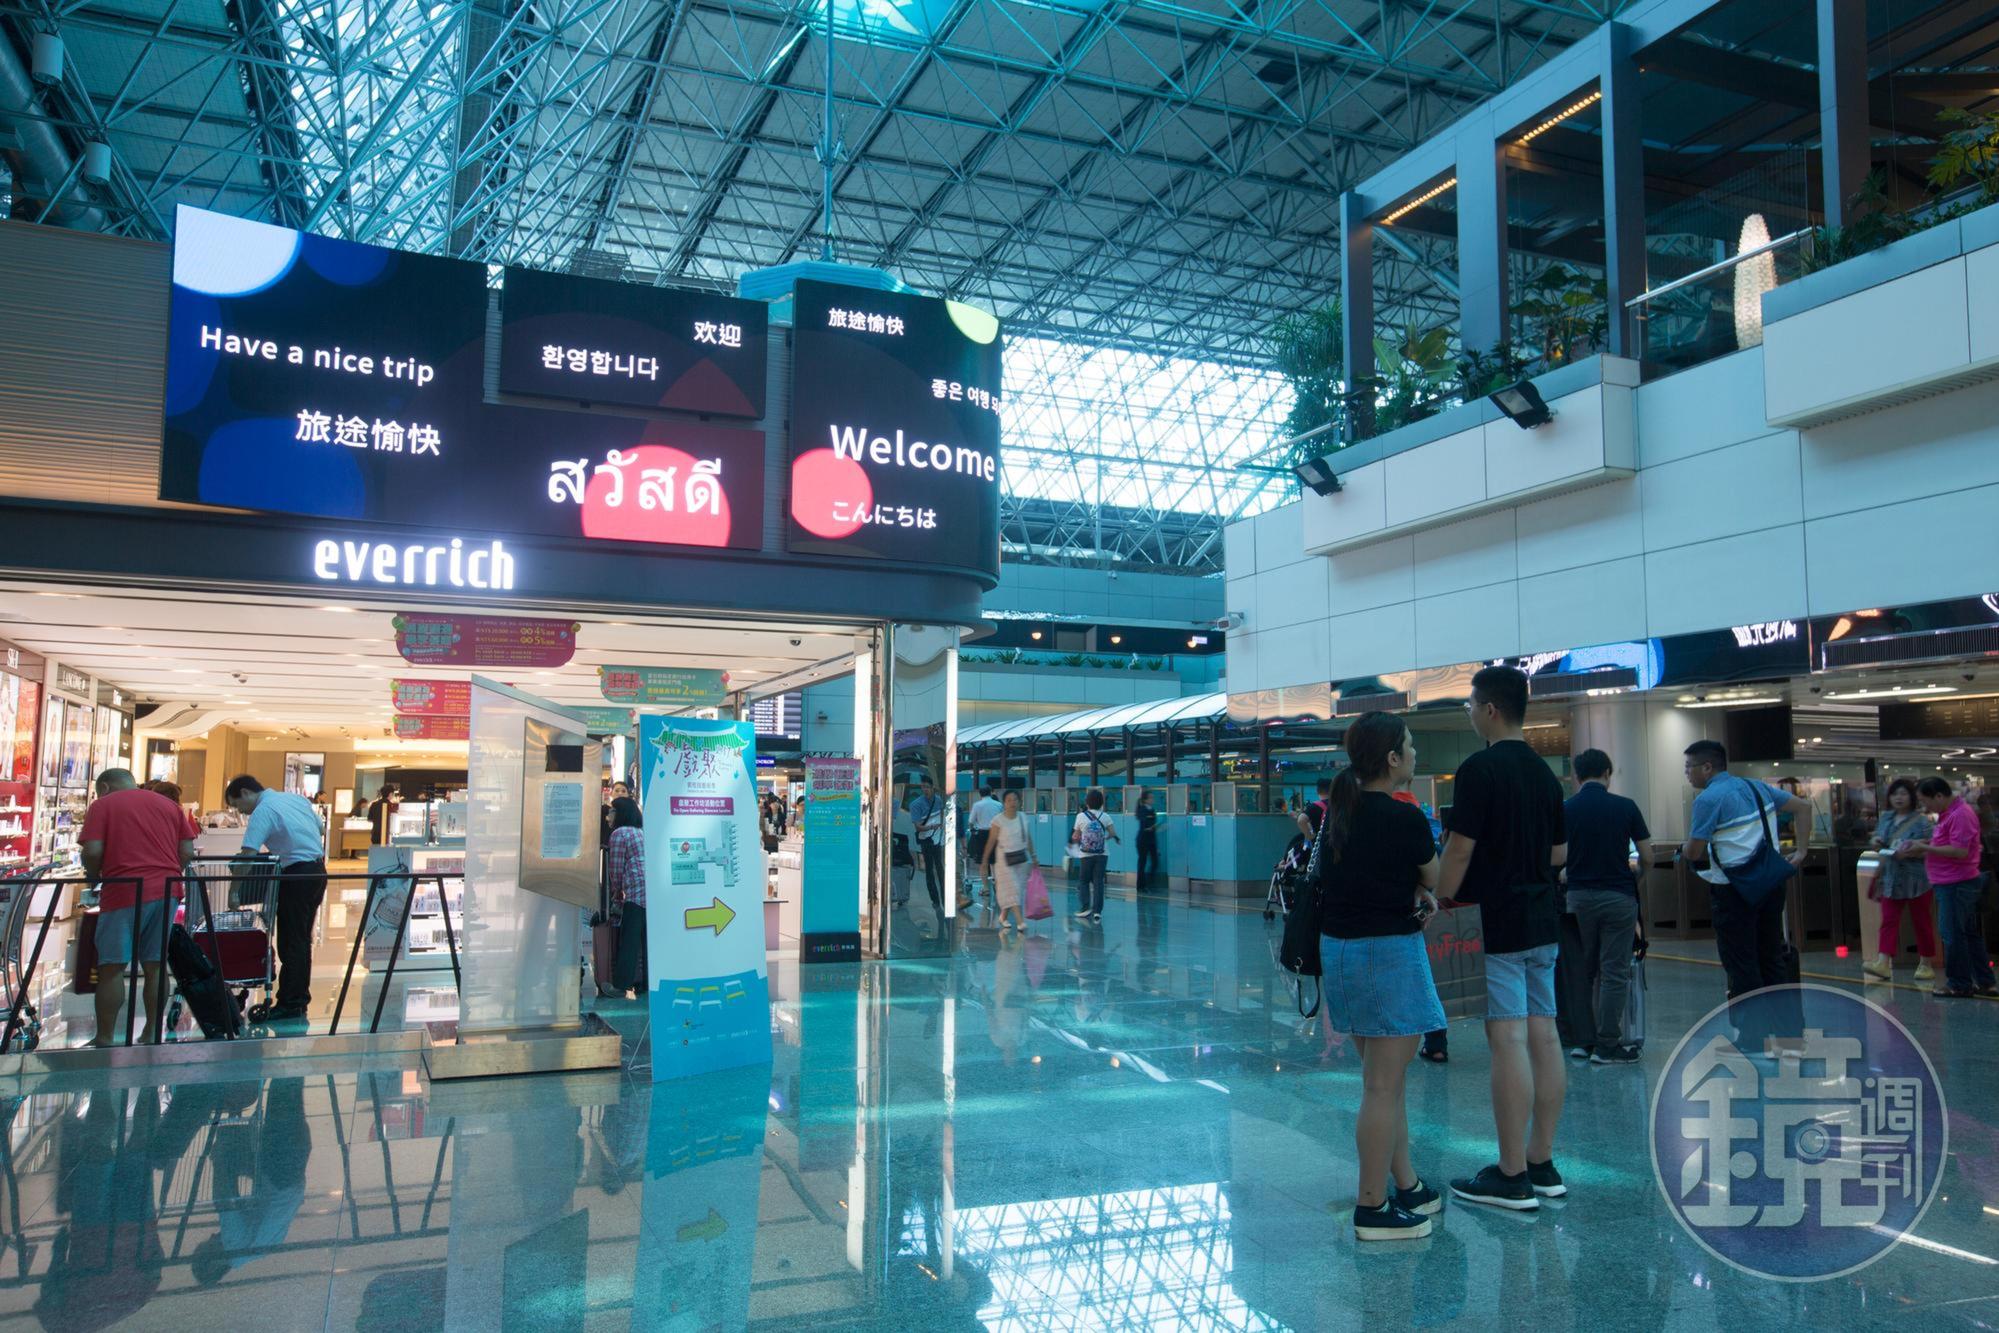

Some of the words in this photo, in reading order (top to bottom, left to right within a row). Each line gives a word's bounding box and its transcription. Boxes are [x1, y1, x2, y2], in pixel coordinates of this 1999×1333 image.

[694, 320, 742, 348] 欢迎
[829, 307, 904, 336] 旅途愉快
[201, 325, 278, 360] Have
[287, 345, 304, 364] a
[314, 346, 374, 375] nice
[383, 356, 434, 387] trip
[541, 344, 660, 381] 환영합니다
[931, 378, 963, 401] 좋은
[295, 408, 441, 456] 旅途愉快
[829, 424, 995, 482] Welcome
[548, 448, 722, 516] สวัสดี
[832, 500, 937, 530] こんにちは
[314, 537, 515, 591] everrich
